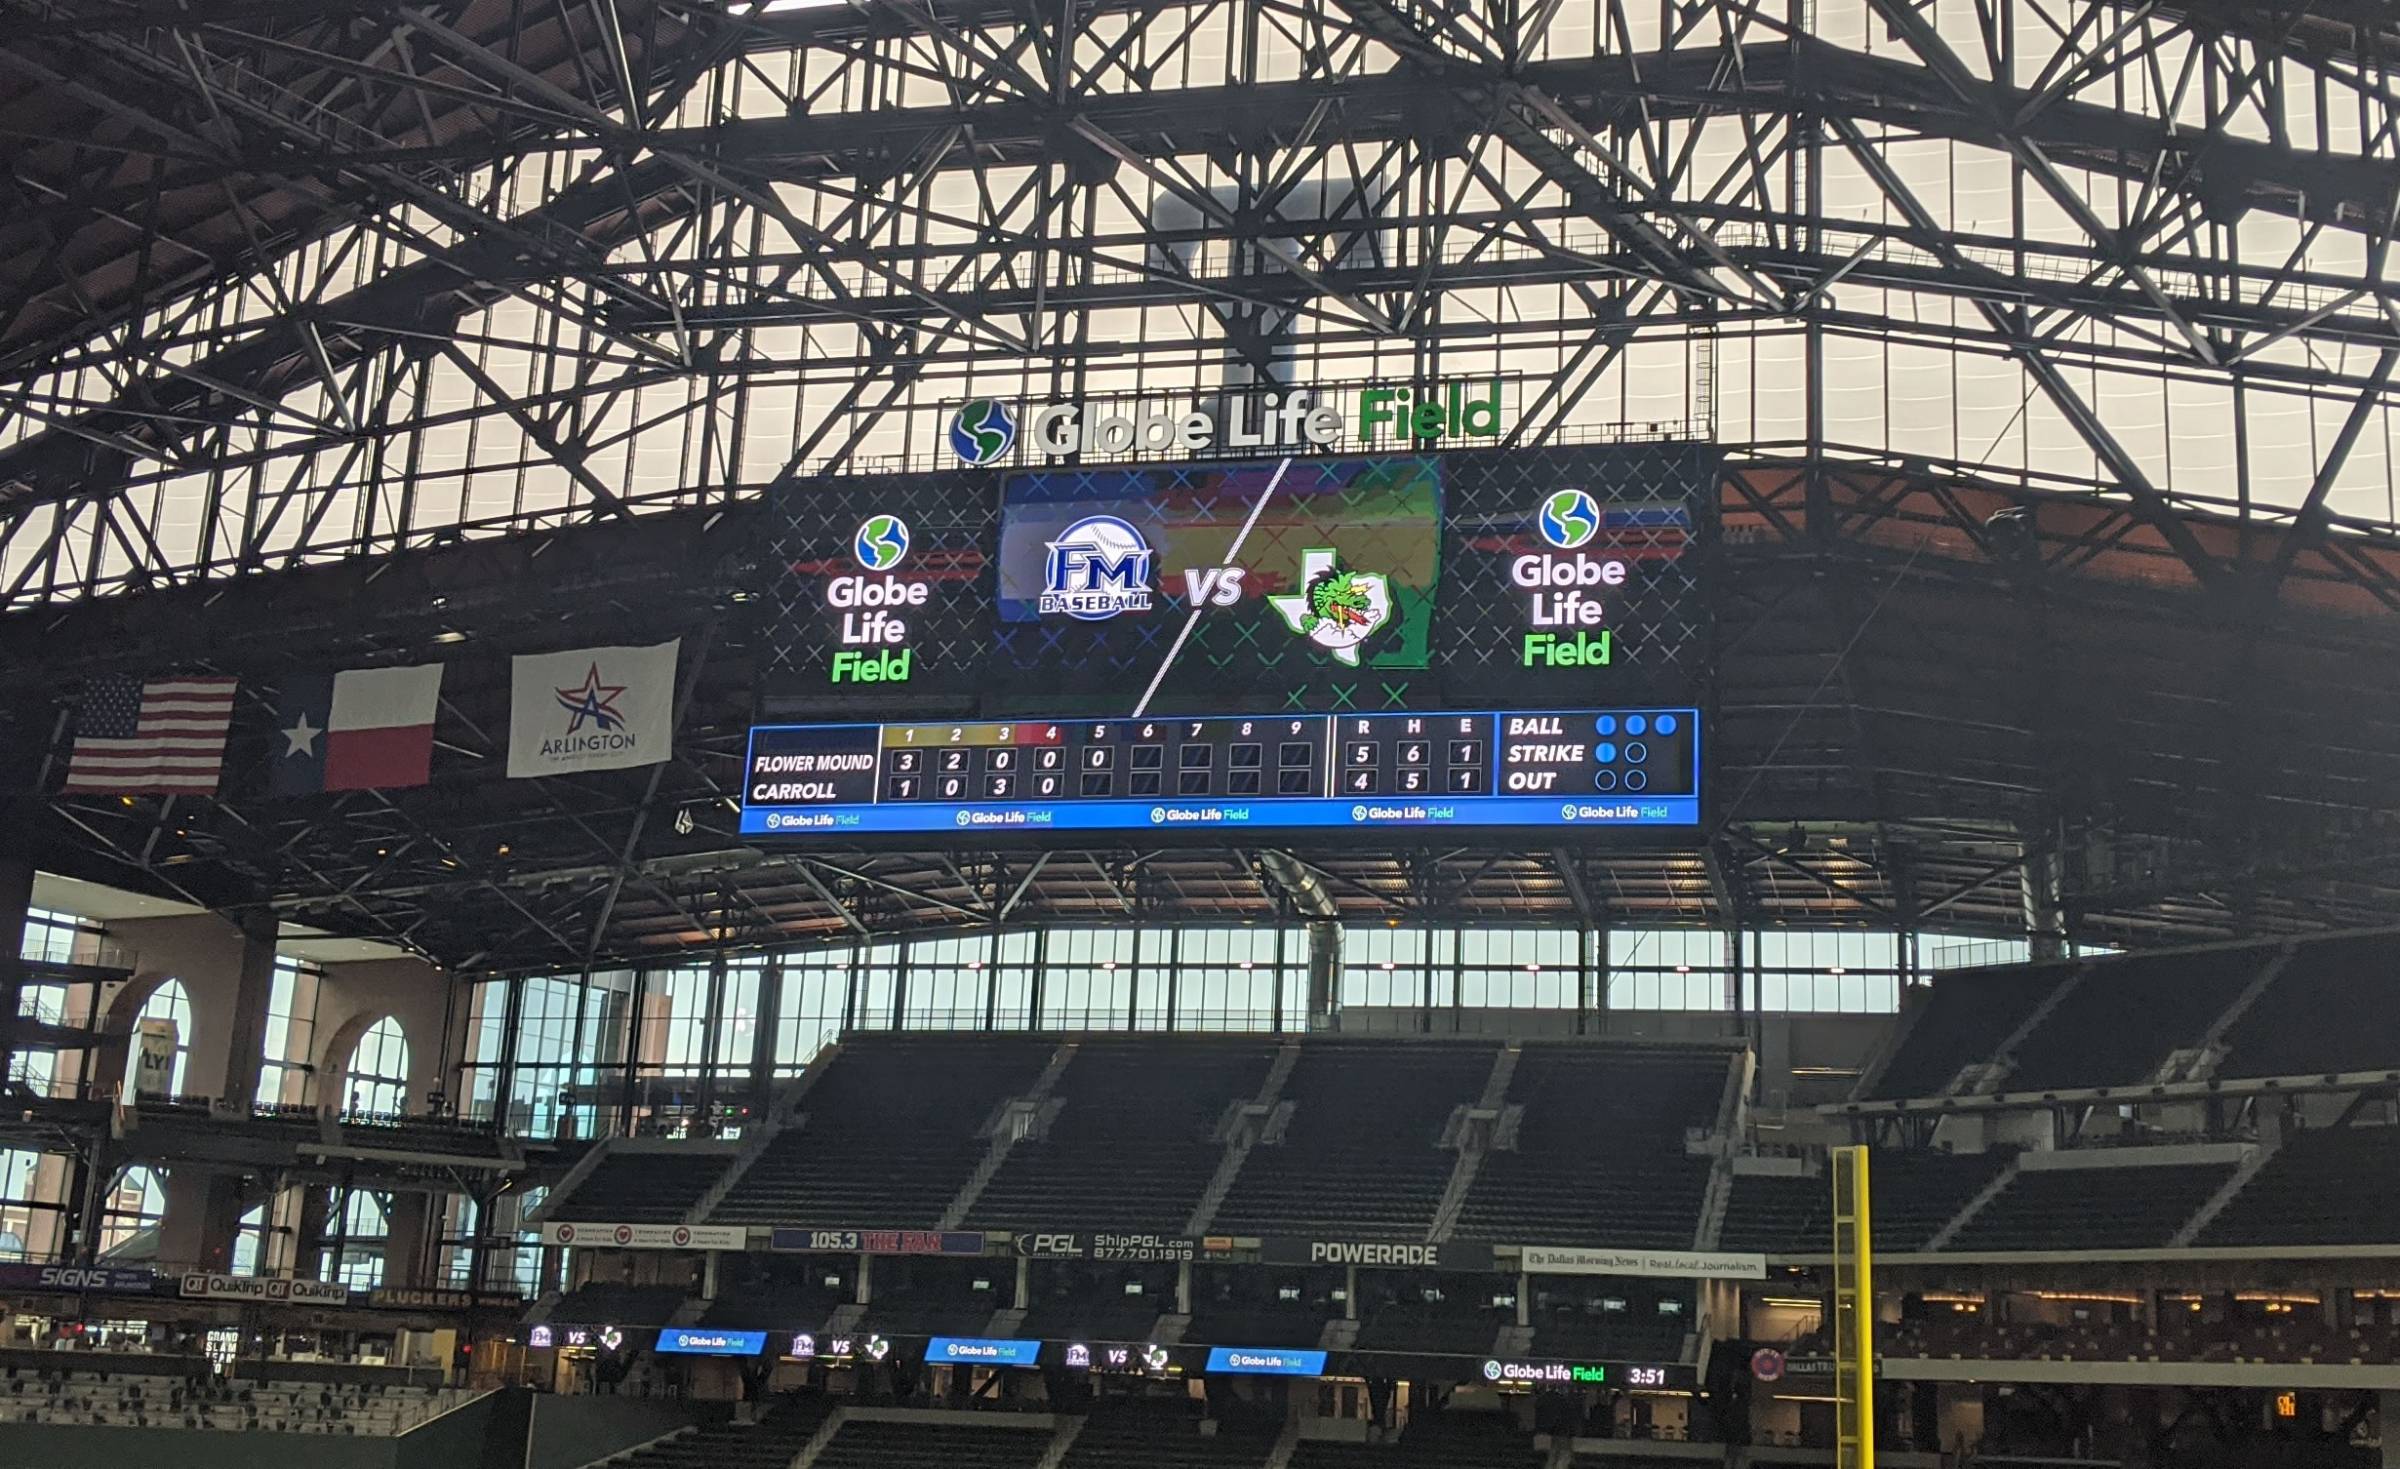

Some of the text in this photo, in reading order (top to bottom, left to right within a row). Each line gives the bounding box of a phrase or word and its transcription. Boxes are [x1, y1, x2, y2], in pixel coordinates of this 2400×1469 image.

[1035, 380, 1501, 456] Globe Life Field
[1044, 540, 1153, 594] FM
[1511, 553, 1626, 587] Globe
[827, 575, 929, 608] Globe
[1184, 567, 1246, 607] VS
[1039, 592, 1153, 615] BASEBALL
[1532, 590, 1603, 626] Life
[841, 610, 906, 645] Life
[1523, 631, 1611, 667] Field
[831, 649, 911, 684] Field
[905, 719, 1472, 743] 1 2 3 4 5 6 7 8 9 R H E
[1508, 718, 1563, 736] BALL
[540, 732, 636, 756] ARLINGTON
[1507, 744, 1585, 763] STRIKE
[755, 745, 1472, 774] FLOWER MOUND 3 2 0 0 0 5 6 1
[752, 772, 1472, 800] CARROLL 1 0 3 0 4 5 1
[1508, 771, 1557, 789] OUT
[782, 814, 860, 826] Globe Life Field
[971, 811, 1052, 824] Globe Life Field
[1166, 808, 1249, 821] Globe Life Field
[1369, 806, 1454, 819] Globe Life Field
[1579, 805, 1668, 818] Globe Life Field
[810, 1232, 857, 1249] 105.3
[1033, 1234, 1083, 1253] PGL
[1311, 1242, 1438, 1265] POWERADE
[39, 1267, 109, 1288] SIGNS
[373, 1290, 473, 1308] PLUCKERS
[568, 1331, 586, 1344] VS
[689, 1335, 711, 1346] Globe
[711, 1336, 726, 1346] Life
[832, 1339, 850, 1354] VS
[958, 1345, 982, 1355] Globe
[982, 1346, 997, 1356] Life
[1108, 1349, 1127, 1363] VS
[1241, 1355, 1265, 1366] Globe
[1265, 1356, 1282, 1367] Life
[1503, 1364, 1604, 1381] Globe Life Field
[1630, 1368, 1665, 1384] 3:51
